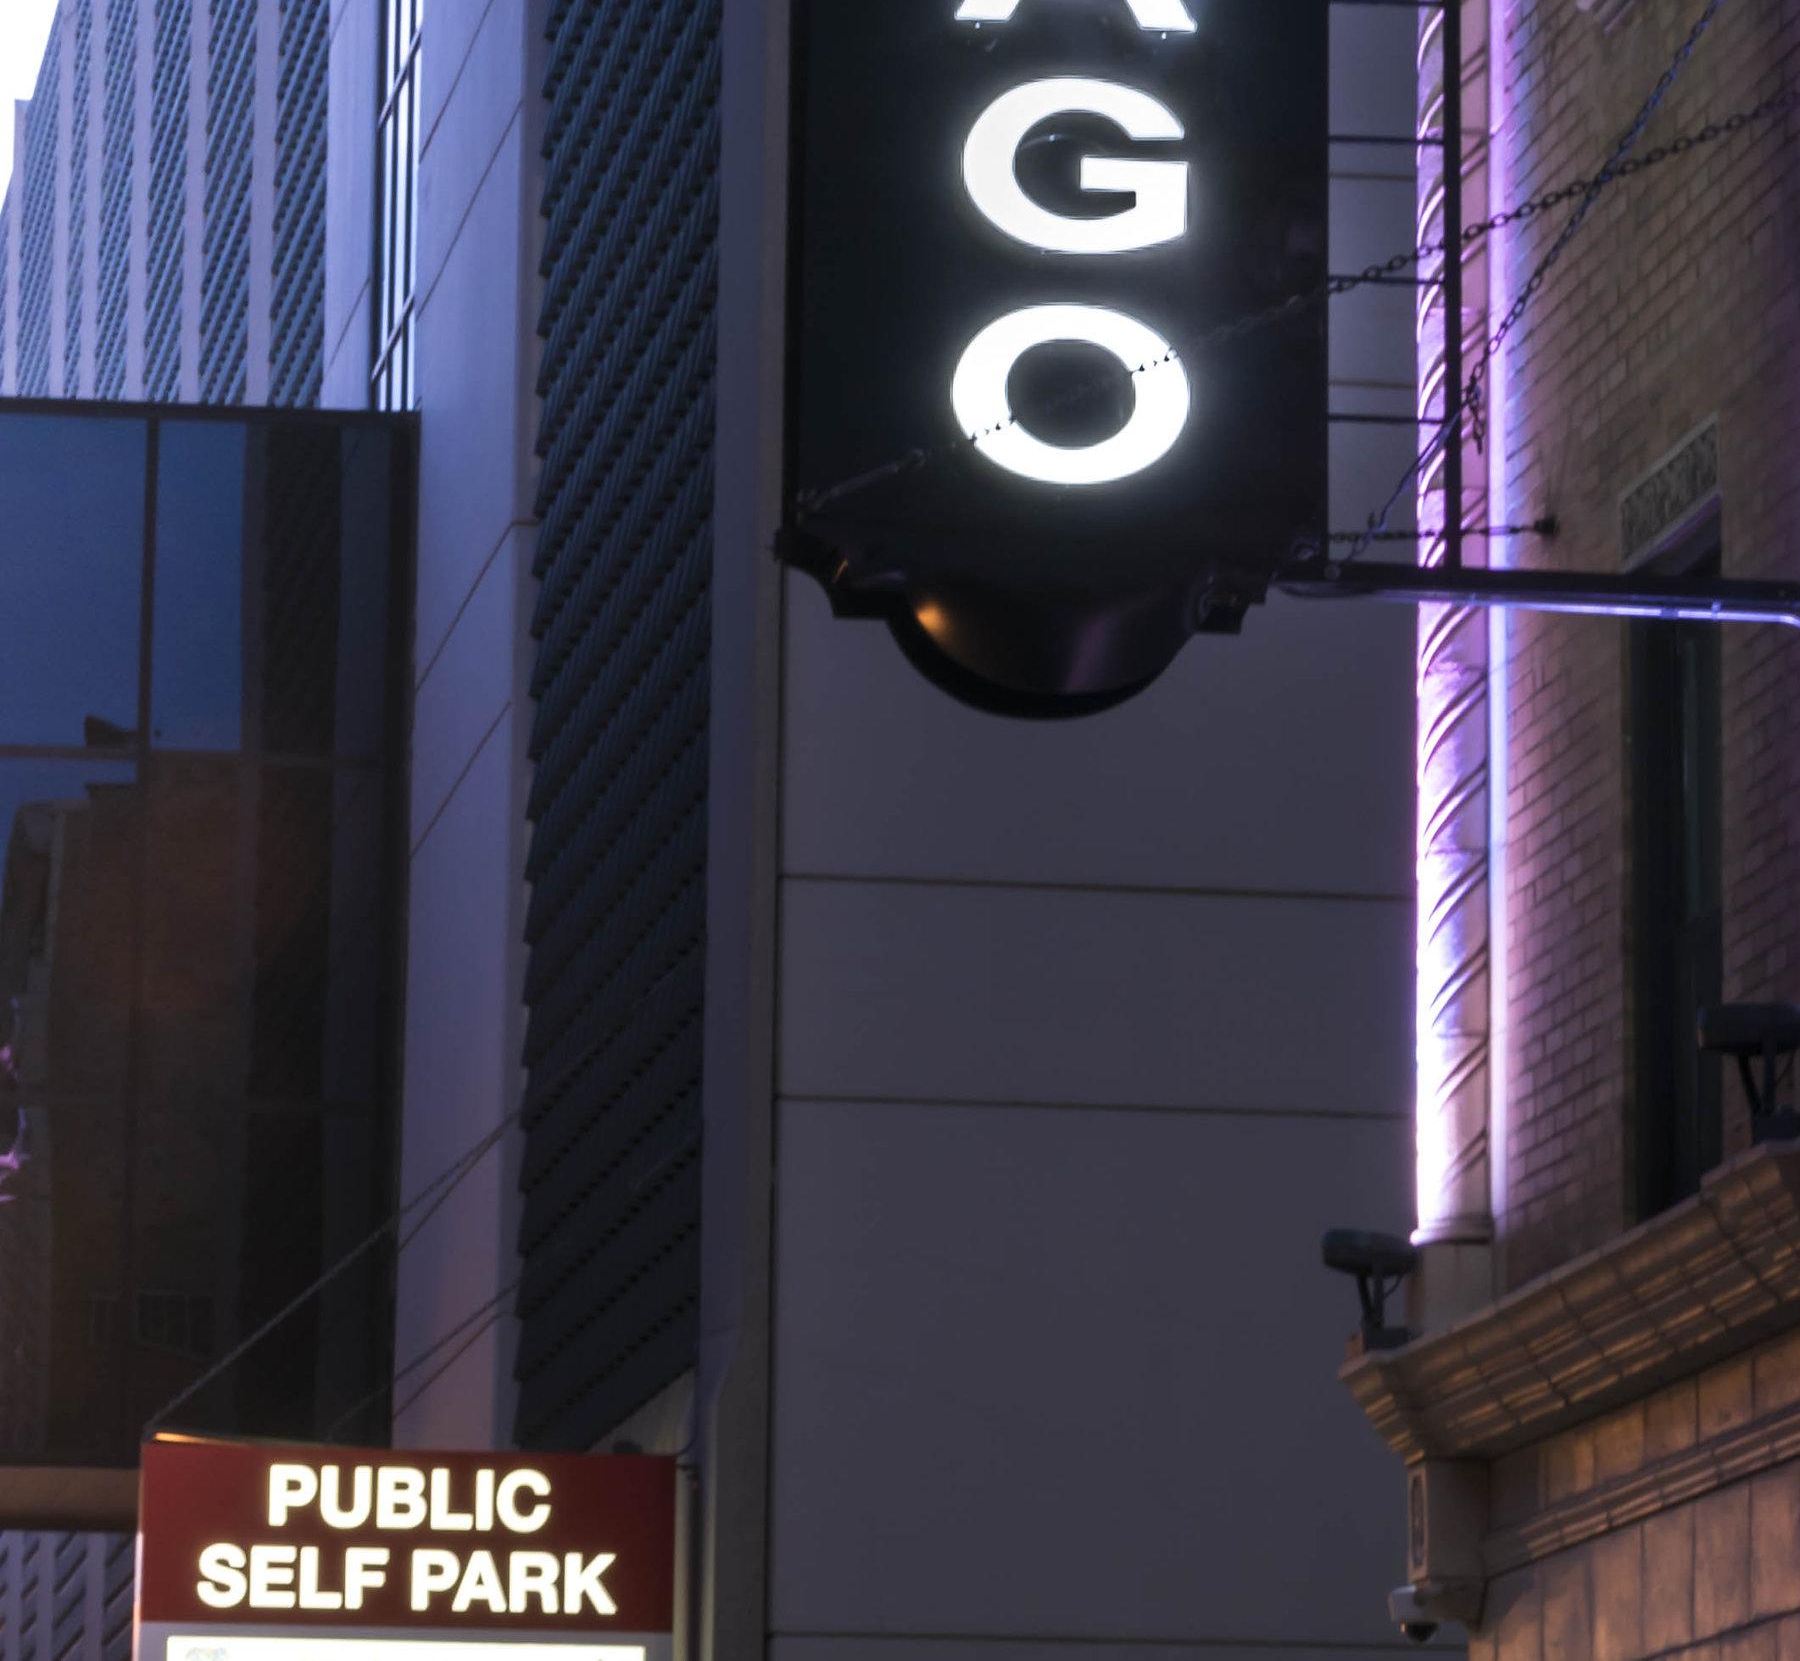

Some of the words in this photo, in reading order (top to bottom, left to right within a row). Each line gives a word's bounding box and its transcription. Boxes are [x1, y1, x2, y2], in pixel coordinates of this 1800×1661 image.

[267, 1462, 552, 1533] PUBLIC
[196, 1542, 391, 1610] SELF
[409, 1549, 618, 1615] PARK
